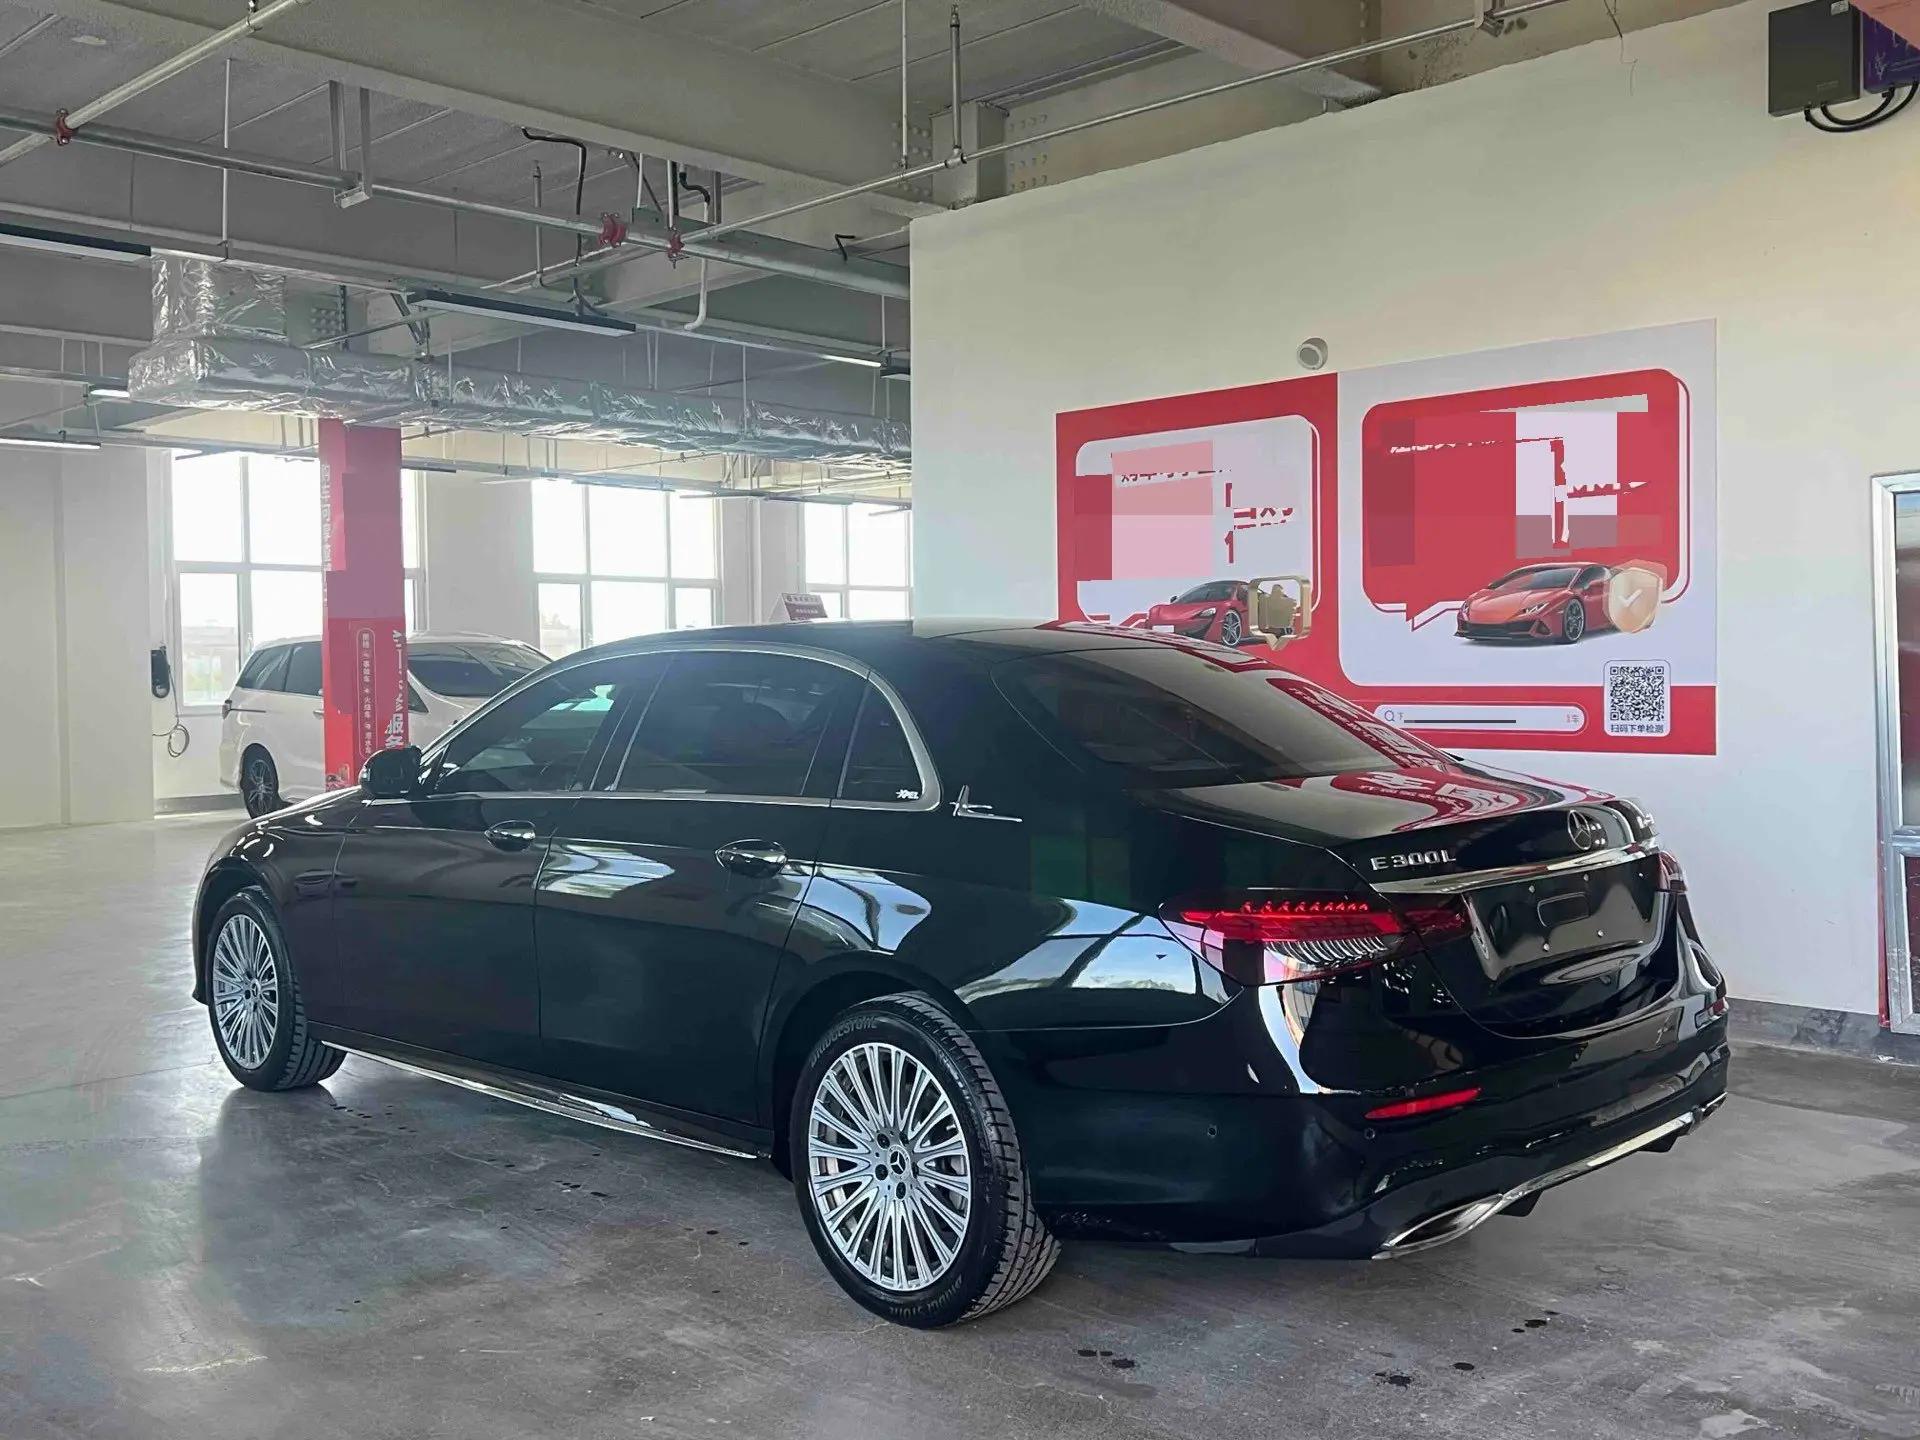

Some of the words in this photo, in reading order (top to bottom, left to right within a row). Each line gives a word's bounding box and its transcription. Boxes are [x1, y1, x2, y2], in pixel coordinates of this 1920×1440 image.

[1610, 724, 1664, 734] 扫码下单检测
